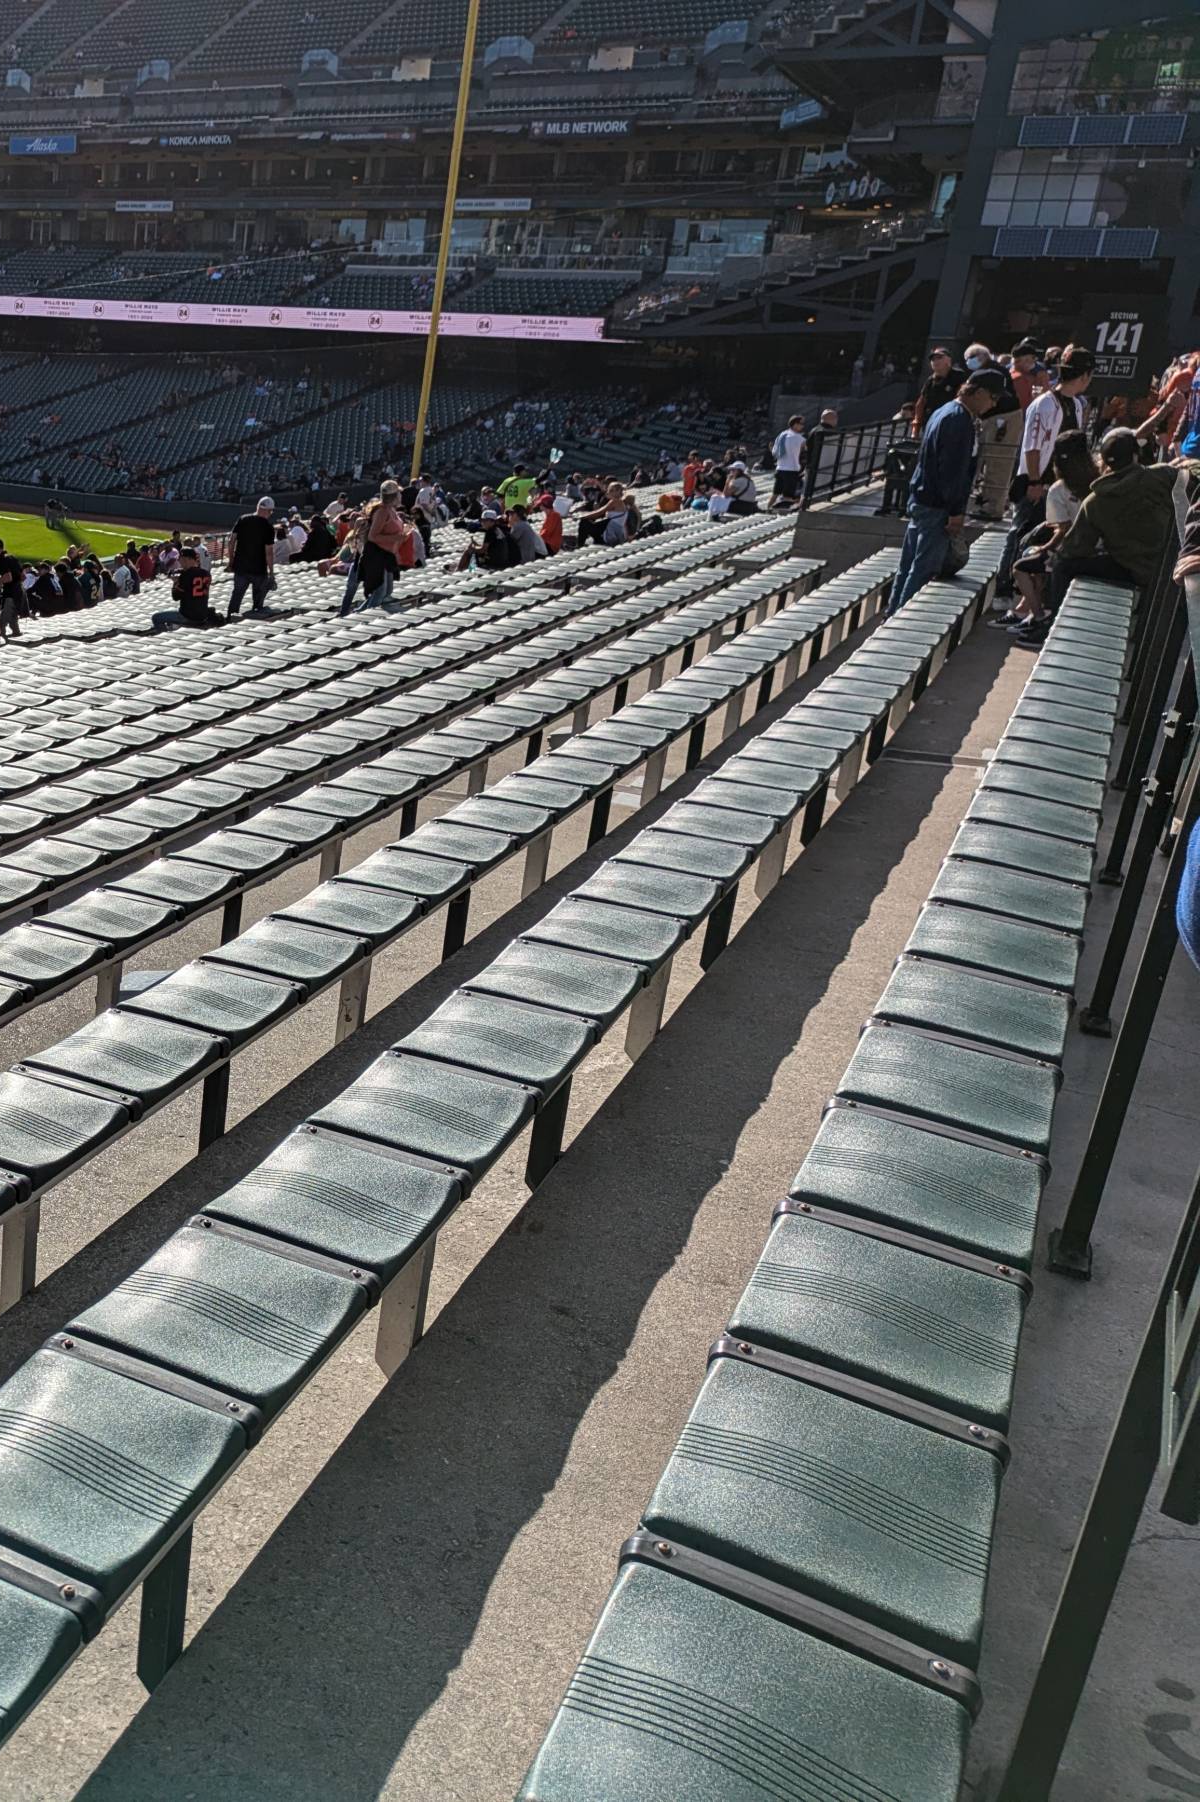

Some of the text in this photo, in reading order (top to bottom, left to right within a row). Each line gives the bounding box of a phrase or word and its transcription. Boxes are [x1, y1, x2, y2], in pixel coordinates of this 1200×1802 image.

[546, 122, 570, 134] MLB
[572, 120, 628, 134] NETWORK
[26, 139, 57, 151] Alaska
[169, 135, 231, 146] KONICA MINOLTA
[1110, 312, 1139, 320] SECTION
[1096, 322, 1144, 353] 141
